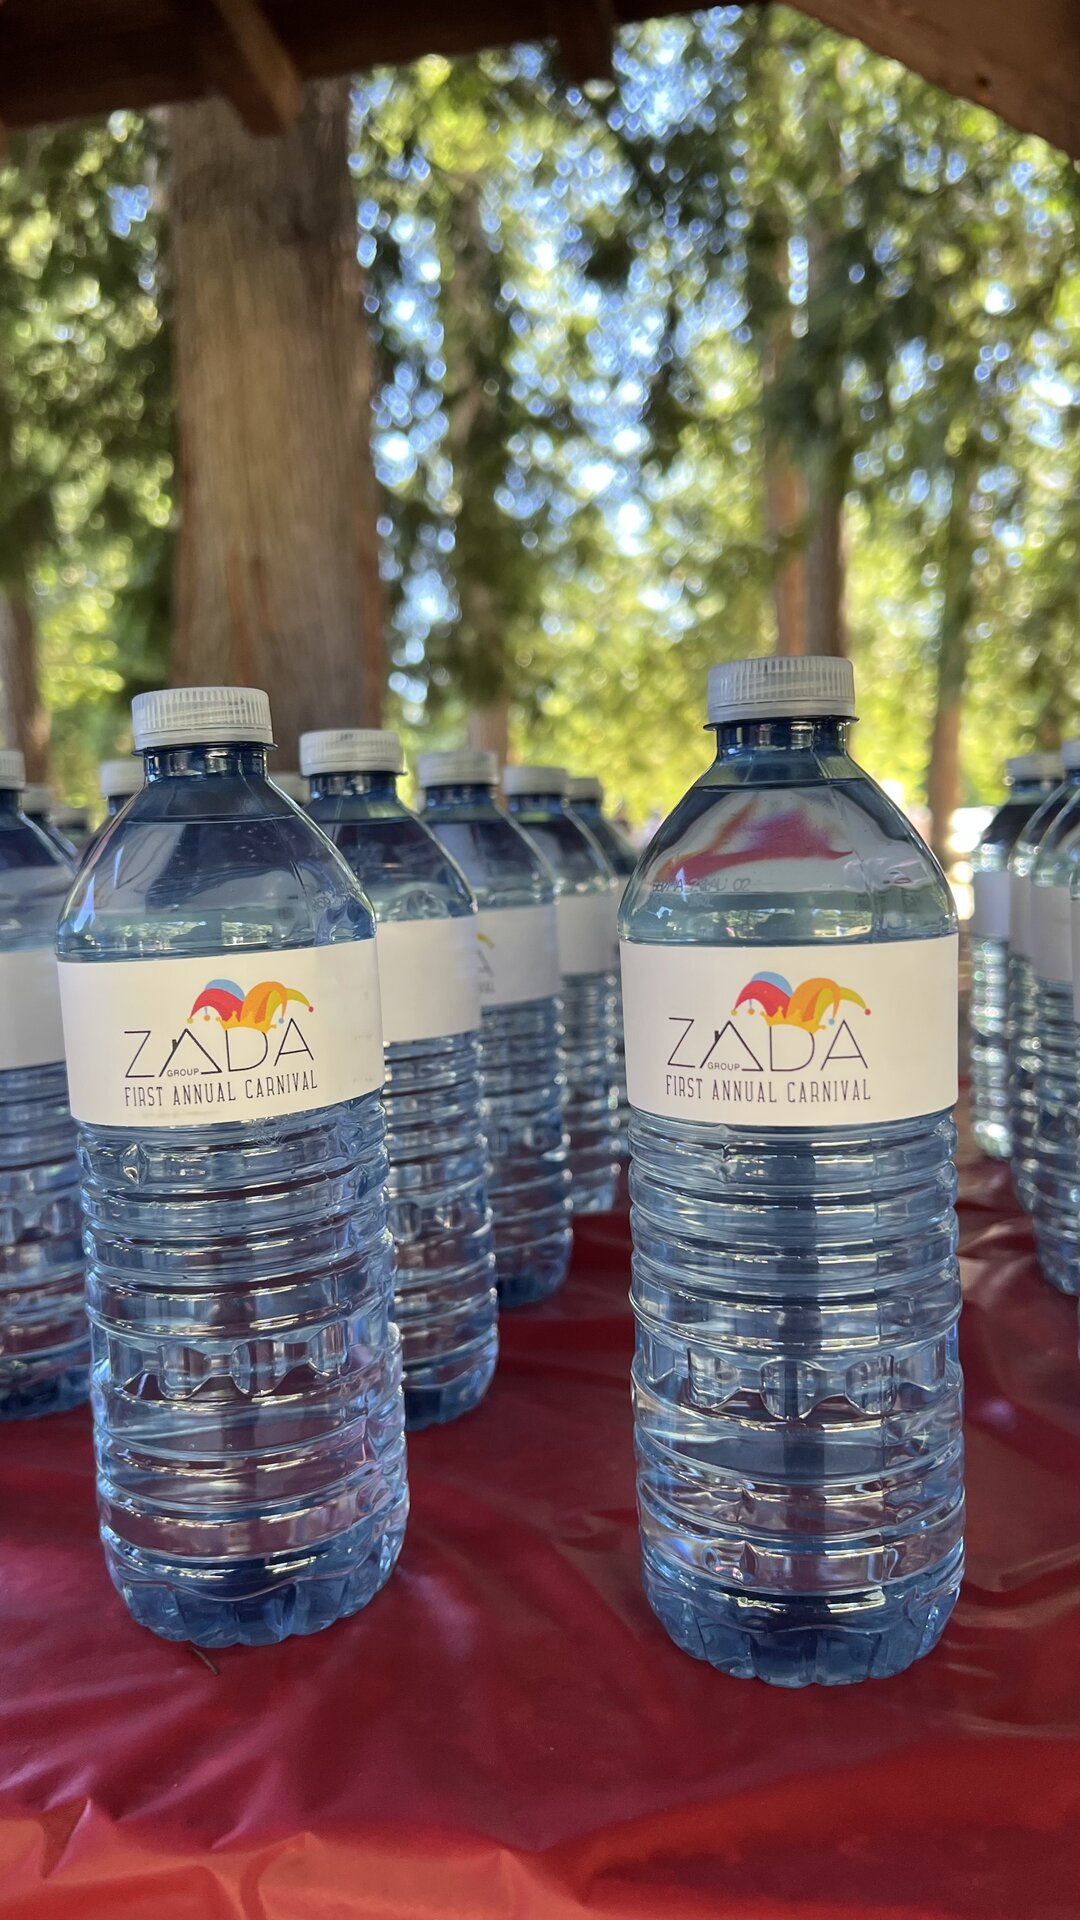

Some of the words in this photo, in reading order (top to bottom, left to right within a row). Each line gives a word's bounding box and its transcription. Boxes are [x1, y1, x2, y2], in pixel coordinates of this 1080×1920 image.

[124, 1017, 314, 1078] ZADA
[667, 1017, 868, 1072] ZADA
[166, 1067, 200, 1078] GROUP
[706, 1061, 741, 1071] GROUP
[124, 1086, 163, 1107] FIRST
[172, 1081, 237, 1106] ANNUAL
[244, 1069, 318, 1099] CARNIVAL
[666, 1074, 703, 1099] FIRST
[711, 1079, 777, 1103] ANNUAL
[787, 1078, 871, 1103] CARNIVAL
